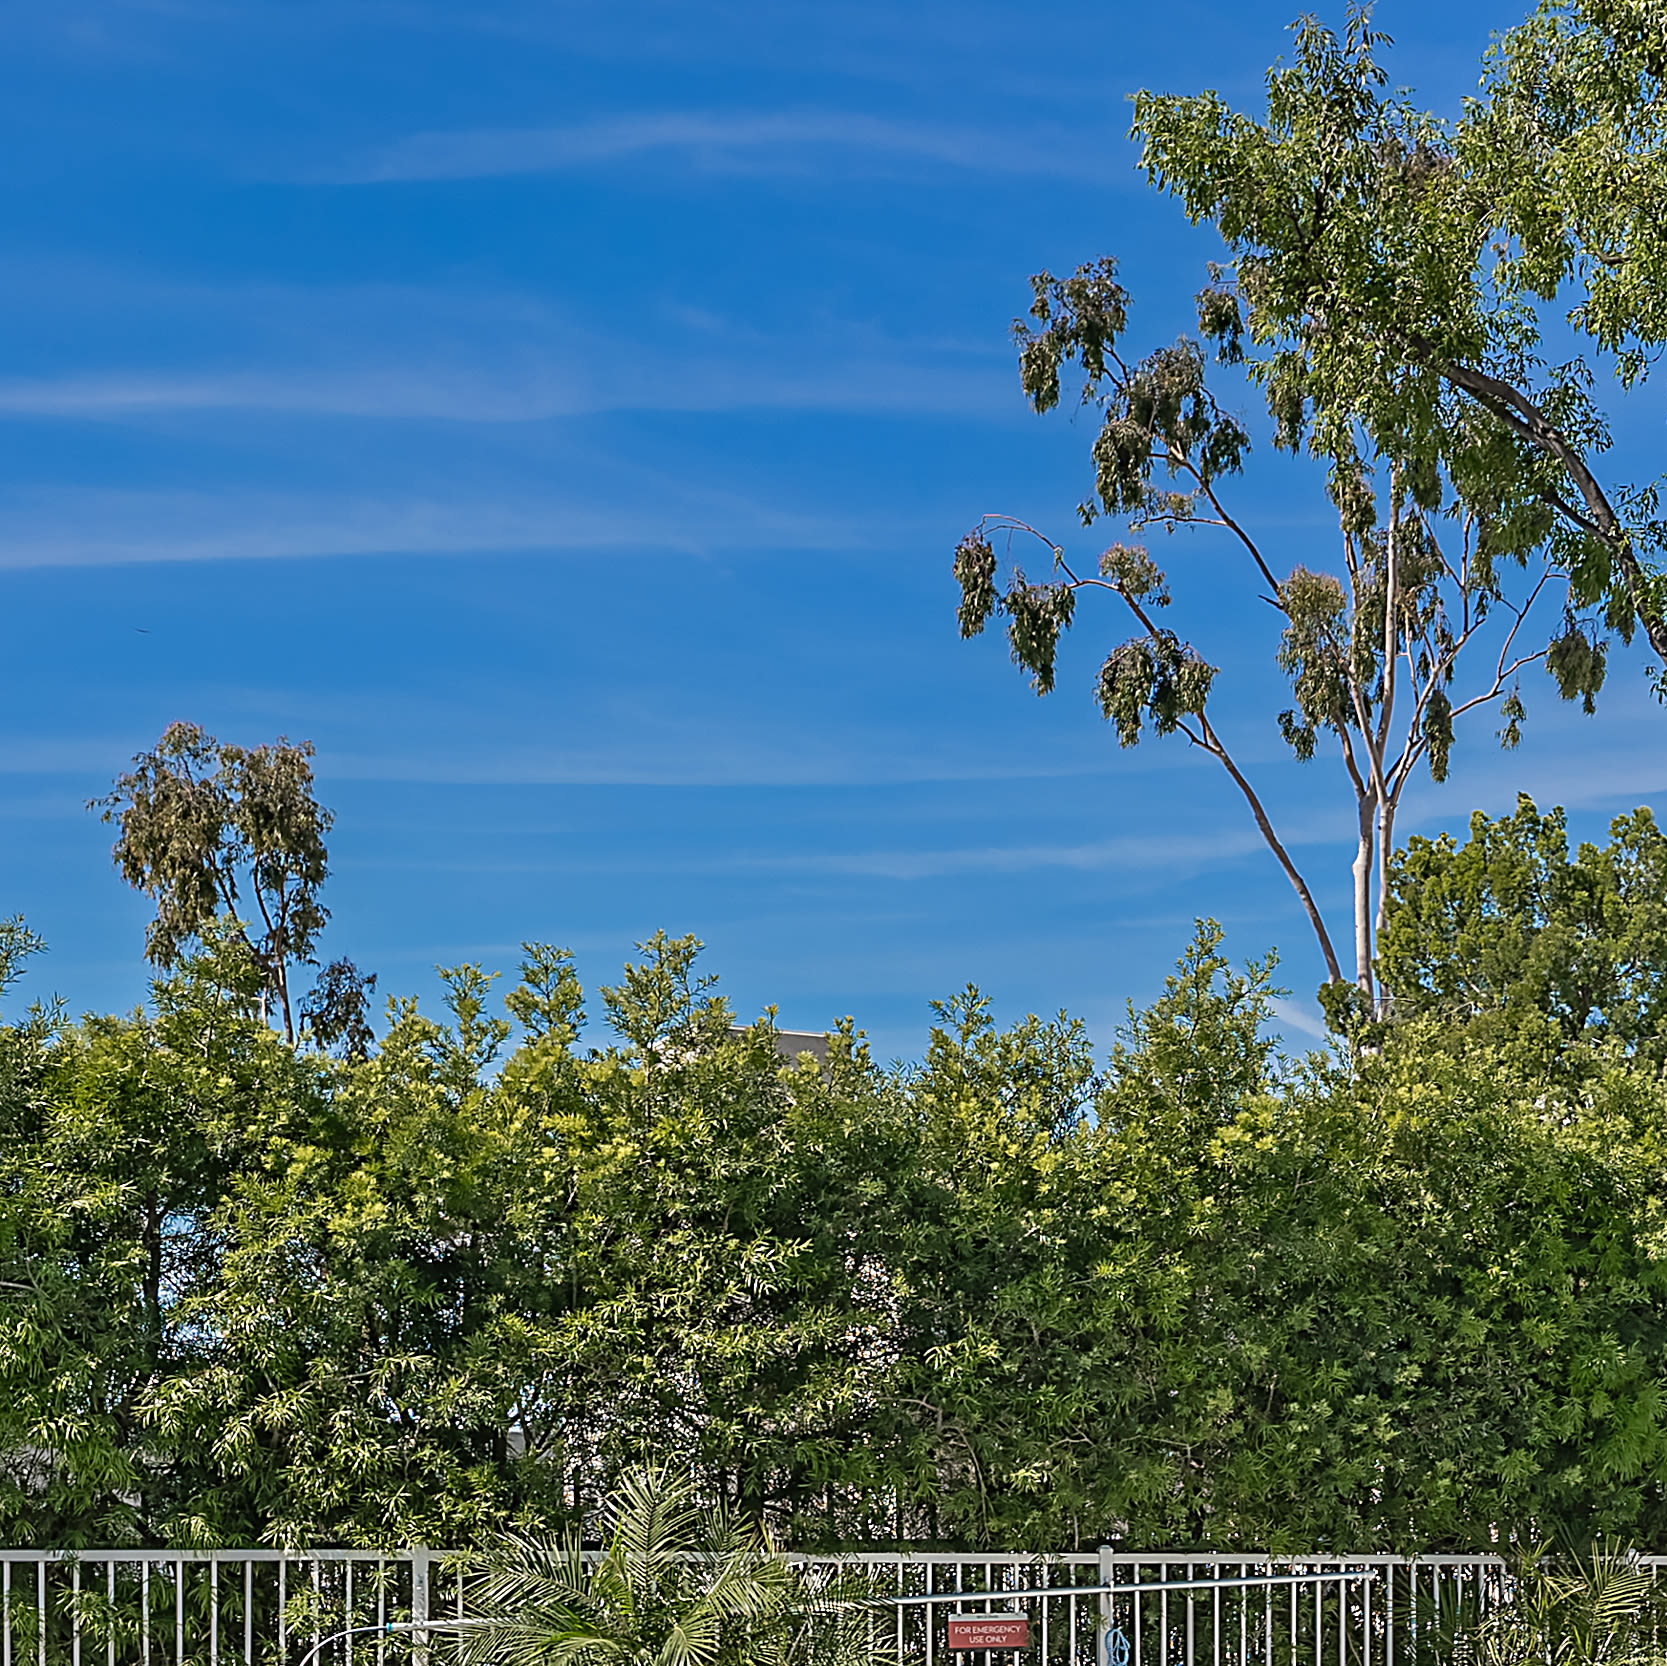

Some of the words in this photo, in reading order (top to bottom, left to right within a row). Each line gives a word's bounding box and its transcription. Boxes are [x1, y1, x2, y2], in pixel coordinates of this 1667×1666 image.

[955, 1626, 971, 1634] FOR
[972, 1625, 1021, 1634] EMERGENCY
[985, 1635, 1007, 1643] ONLY
